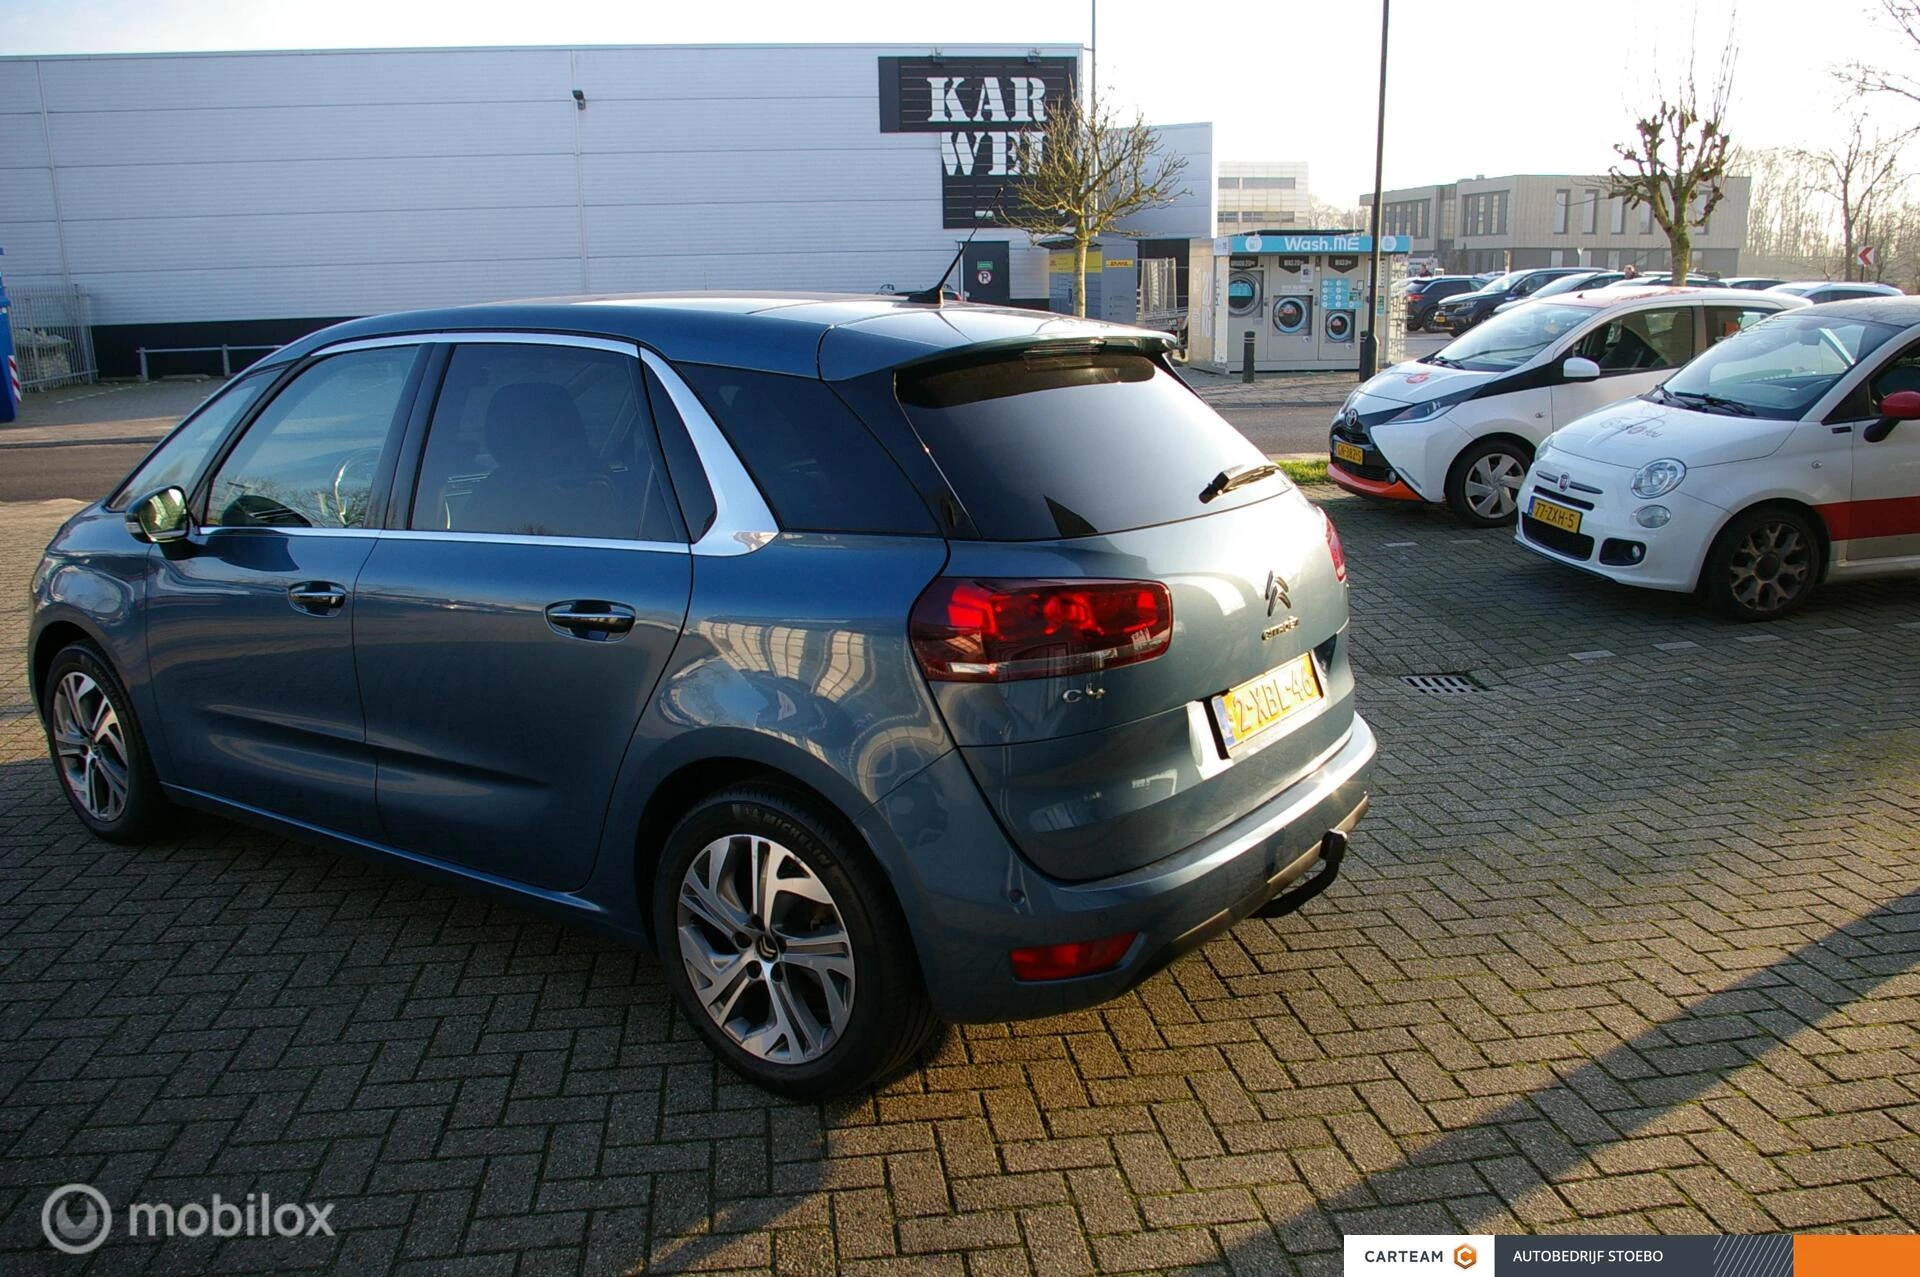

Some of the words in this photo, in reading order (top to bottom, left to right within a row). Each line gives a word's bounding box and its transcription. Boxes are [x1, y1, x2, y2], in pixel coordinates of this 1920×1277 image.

[926, 76, 1047, 122] KAR
[1284, 237, 1360, 251] Wash.ME
[1535, 501, 1575, 528] 77-ZXH-5
[1062, 682, 1106, 702] C4
[1232, 664, 1314, 732] 2-XBL-46
